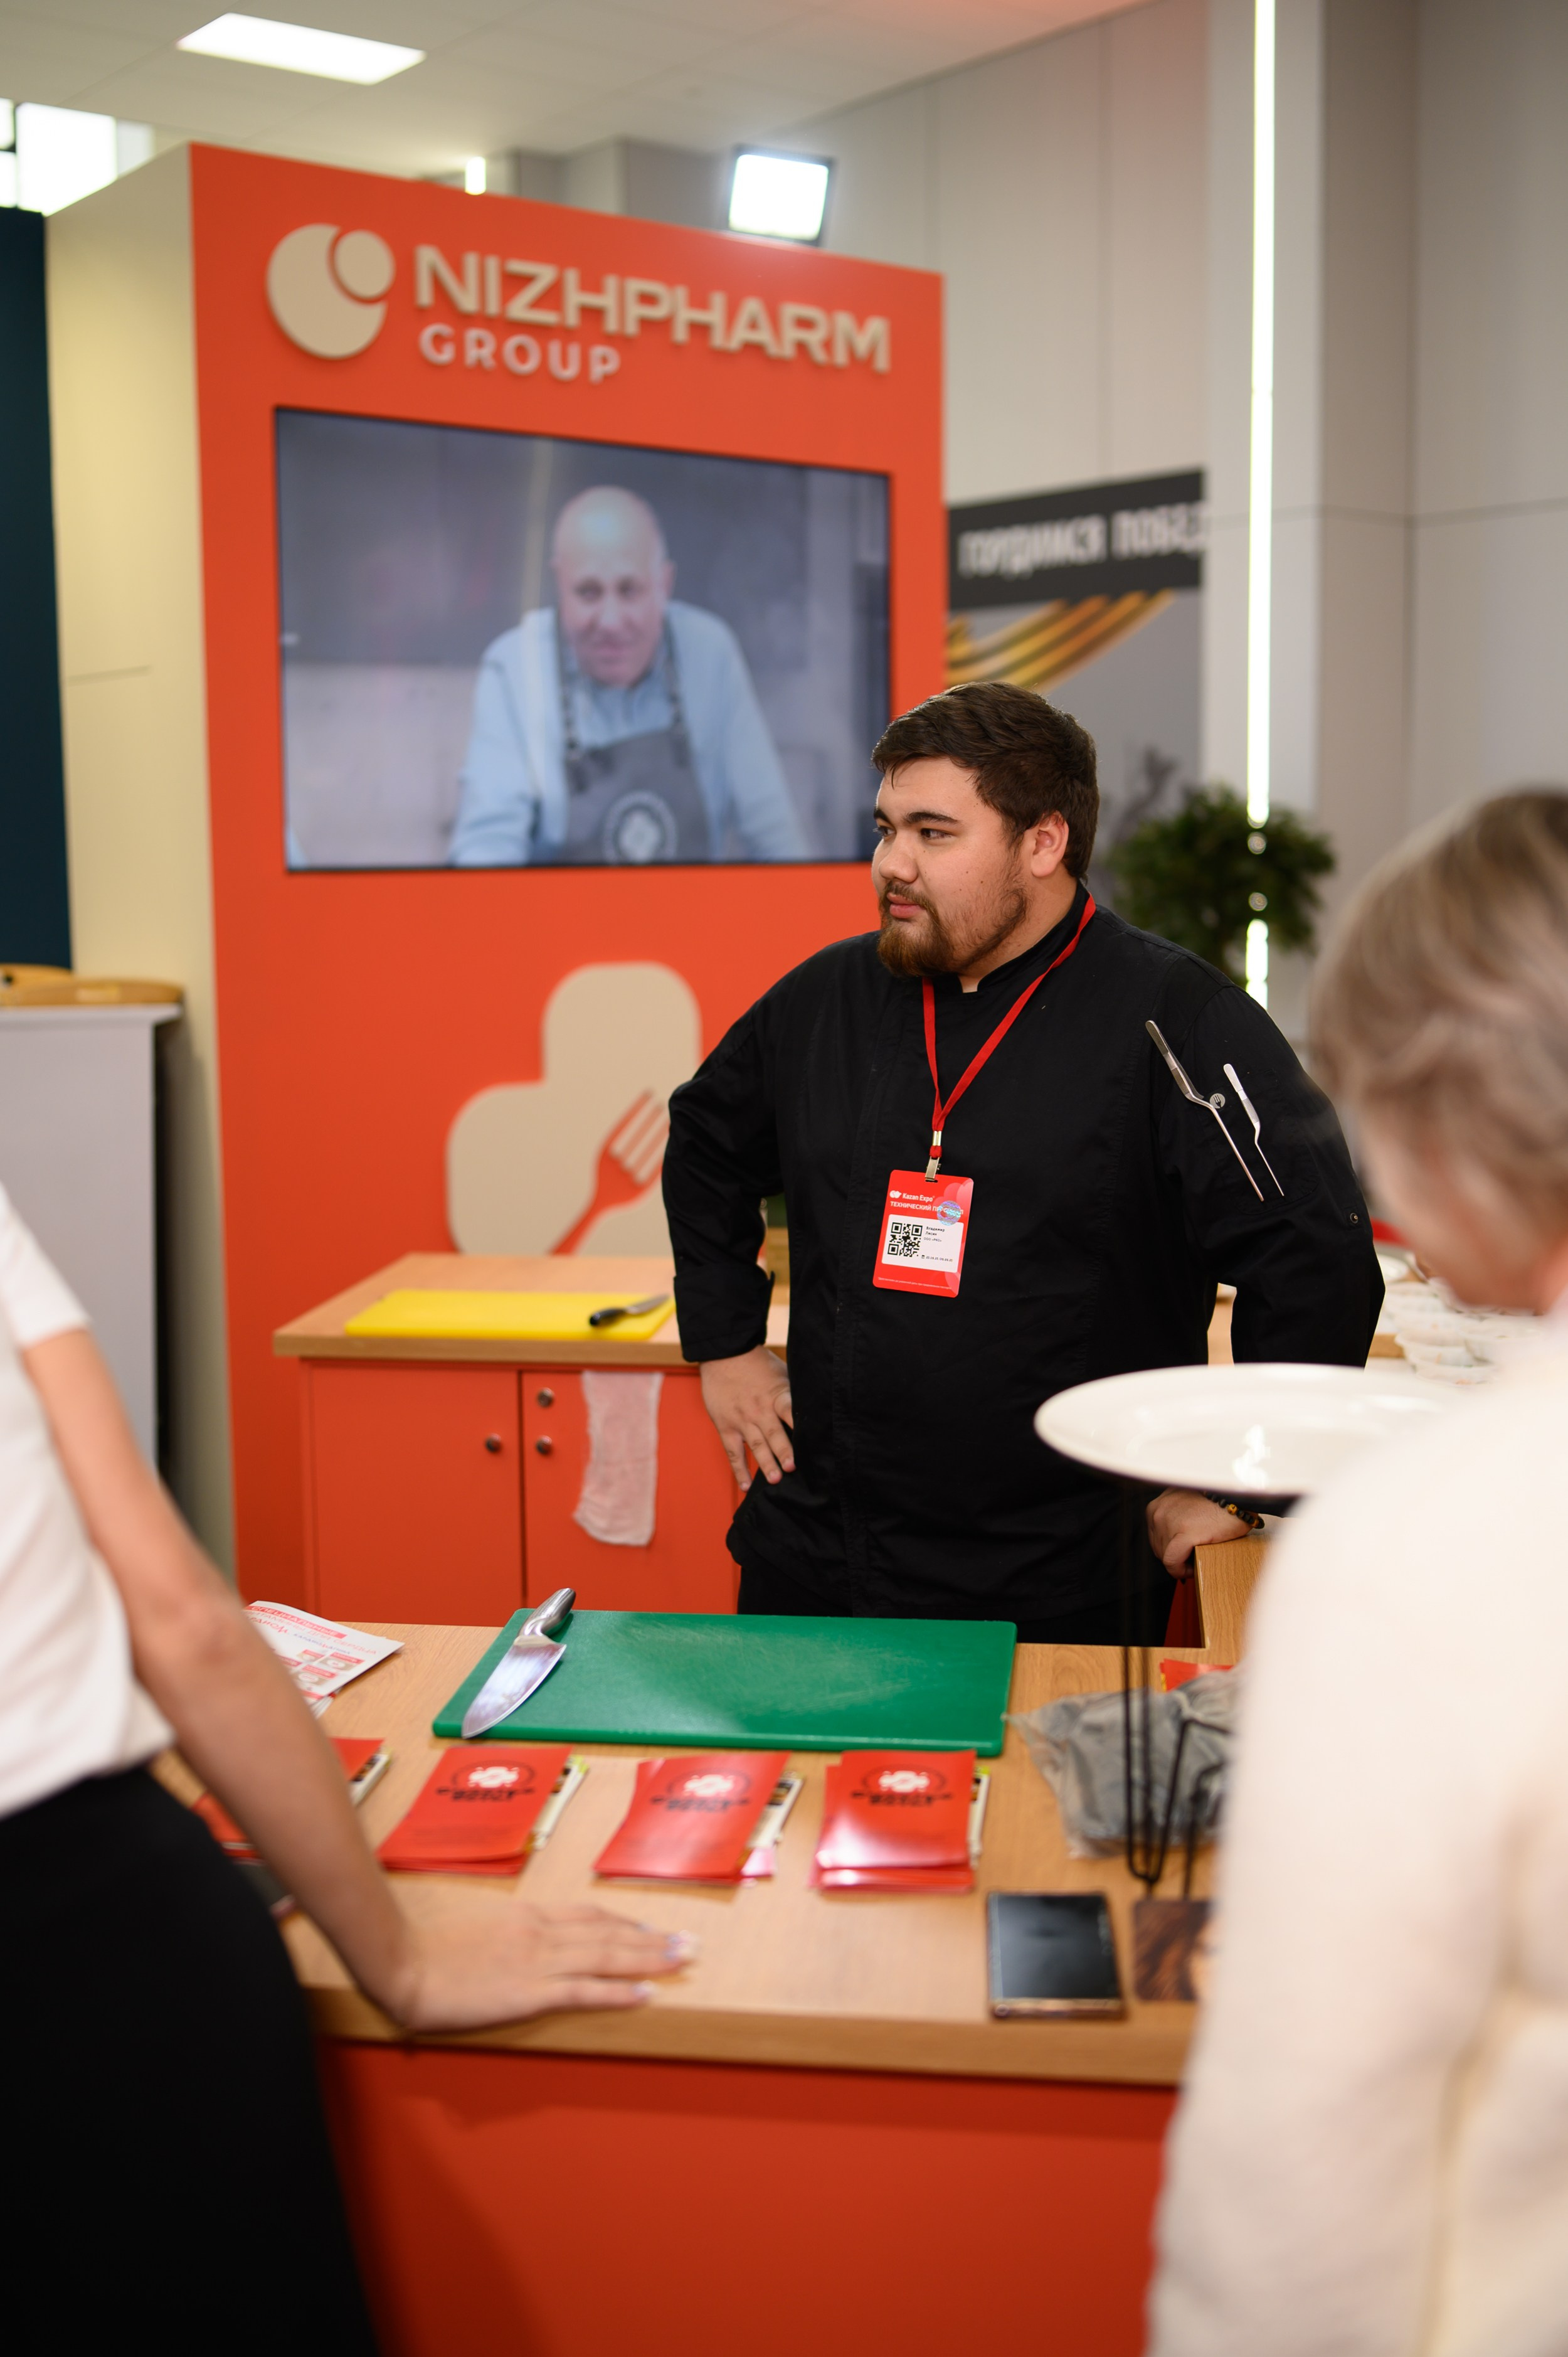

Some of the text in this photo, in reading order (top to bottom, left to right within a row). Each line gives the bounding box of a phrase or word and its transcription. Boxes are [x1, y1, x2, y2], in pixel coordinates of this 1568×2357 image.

[415, 245, 891, 372] NIZHPHARM
[419, 324, 620, 383] GROUP
[890, 1201, 931, 1211] ТЕХНИЧЕСКИЙ
[919, 1194, 933, 1203] Expo
